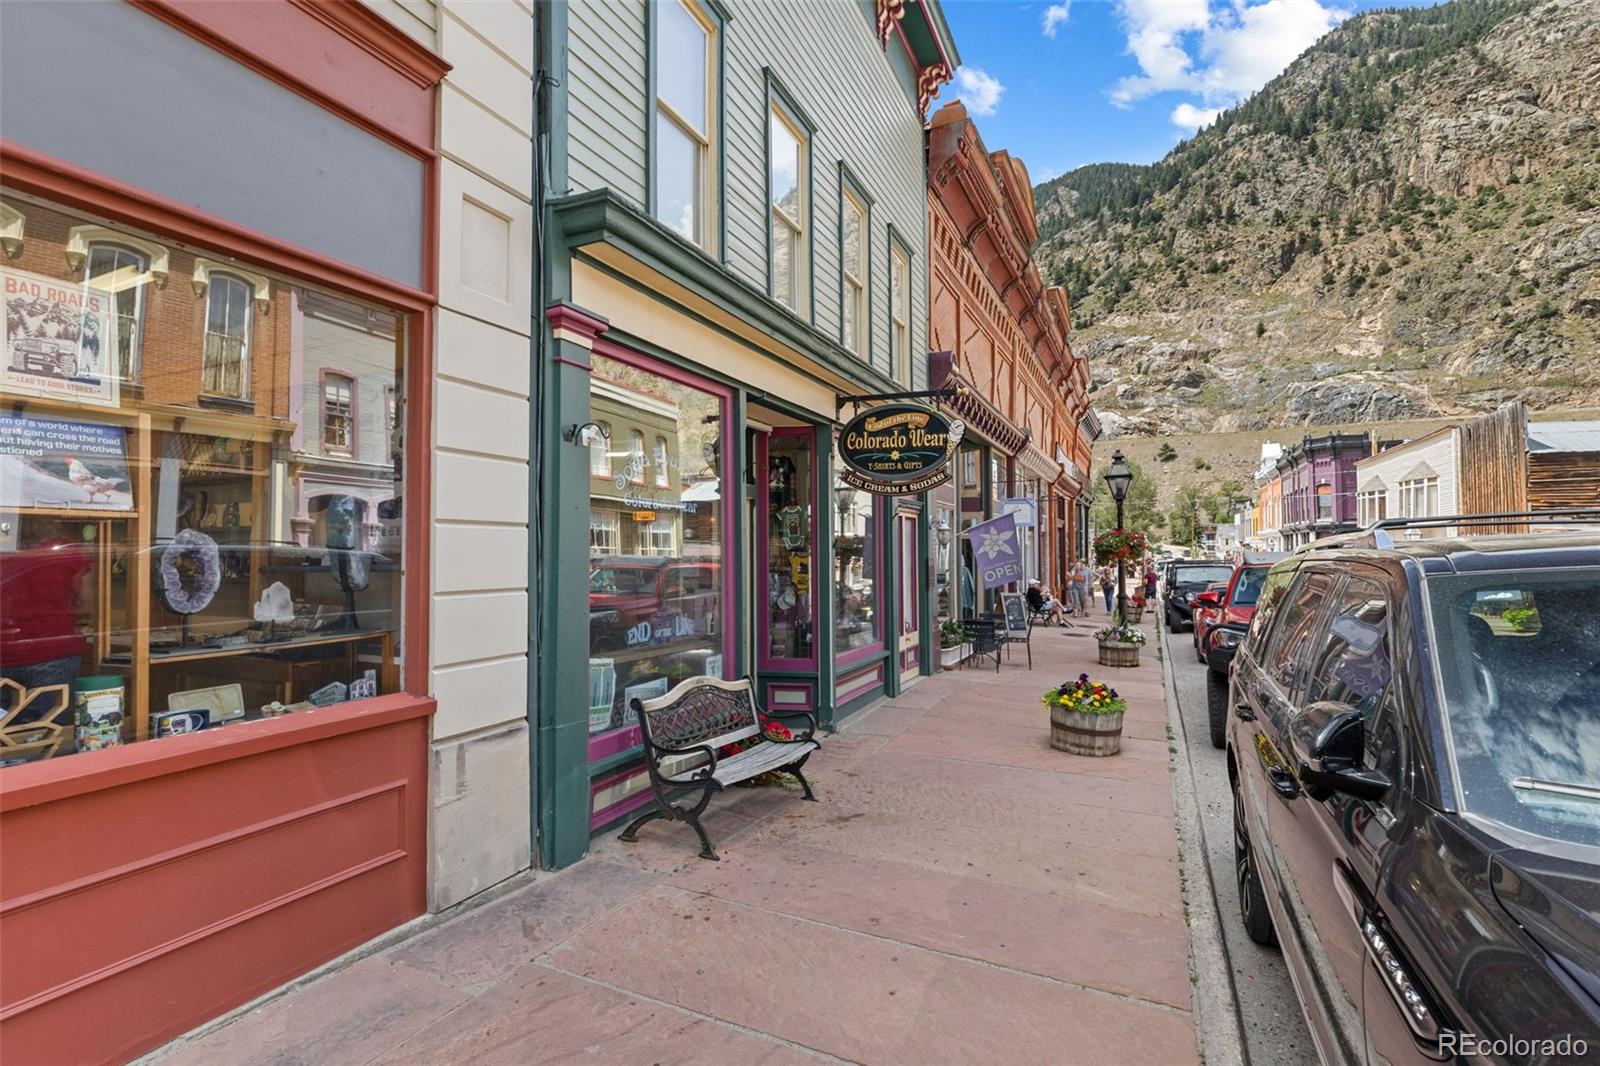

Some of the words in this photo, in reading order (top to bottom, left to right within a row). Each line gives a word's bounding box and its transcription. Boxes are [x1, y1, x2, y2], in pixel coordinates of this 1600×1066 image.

[5, 277, 41, 300] BAD
[47, 287, 100, 313] ROADS
[16, 375, 35, 385] LEAD
[15, 418, 27, 426] of
[28, 420, 36, 428] a
[37, 420, 69, 431] world
[70, 425, 103, 435] where
[17, 437, 53, 450] having
[55, 441, 81, 450] their
[82, 443, 122, 455] motives
[24, 429, 45, 438] can
[47, 432, 78, 441] cross
[79, 433, 96, 443] the
[98, 437, 121, 446] road
[847, 431, 906, 450] Colorado
[909, 429, 947, 447] Wear
[868, 462, 897, 471] T-SHIRTS
[903, 461, 923, 470] GIFTS
[846, 474, 863, 487] ICE
[864, 482, 899, 493] CREAM
[910, 472, 946, 491] SODAS
[984, 564, 1020, 582] OPEN
[627, 621, 651, 645] END
